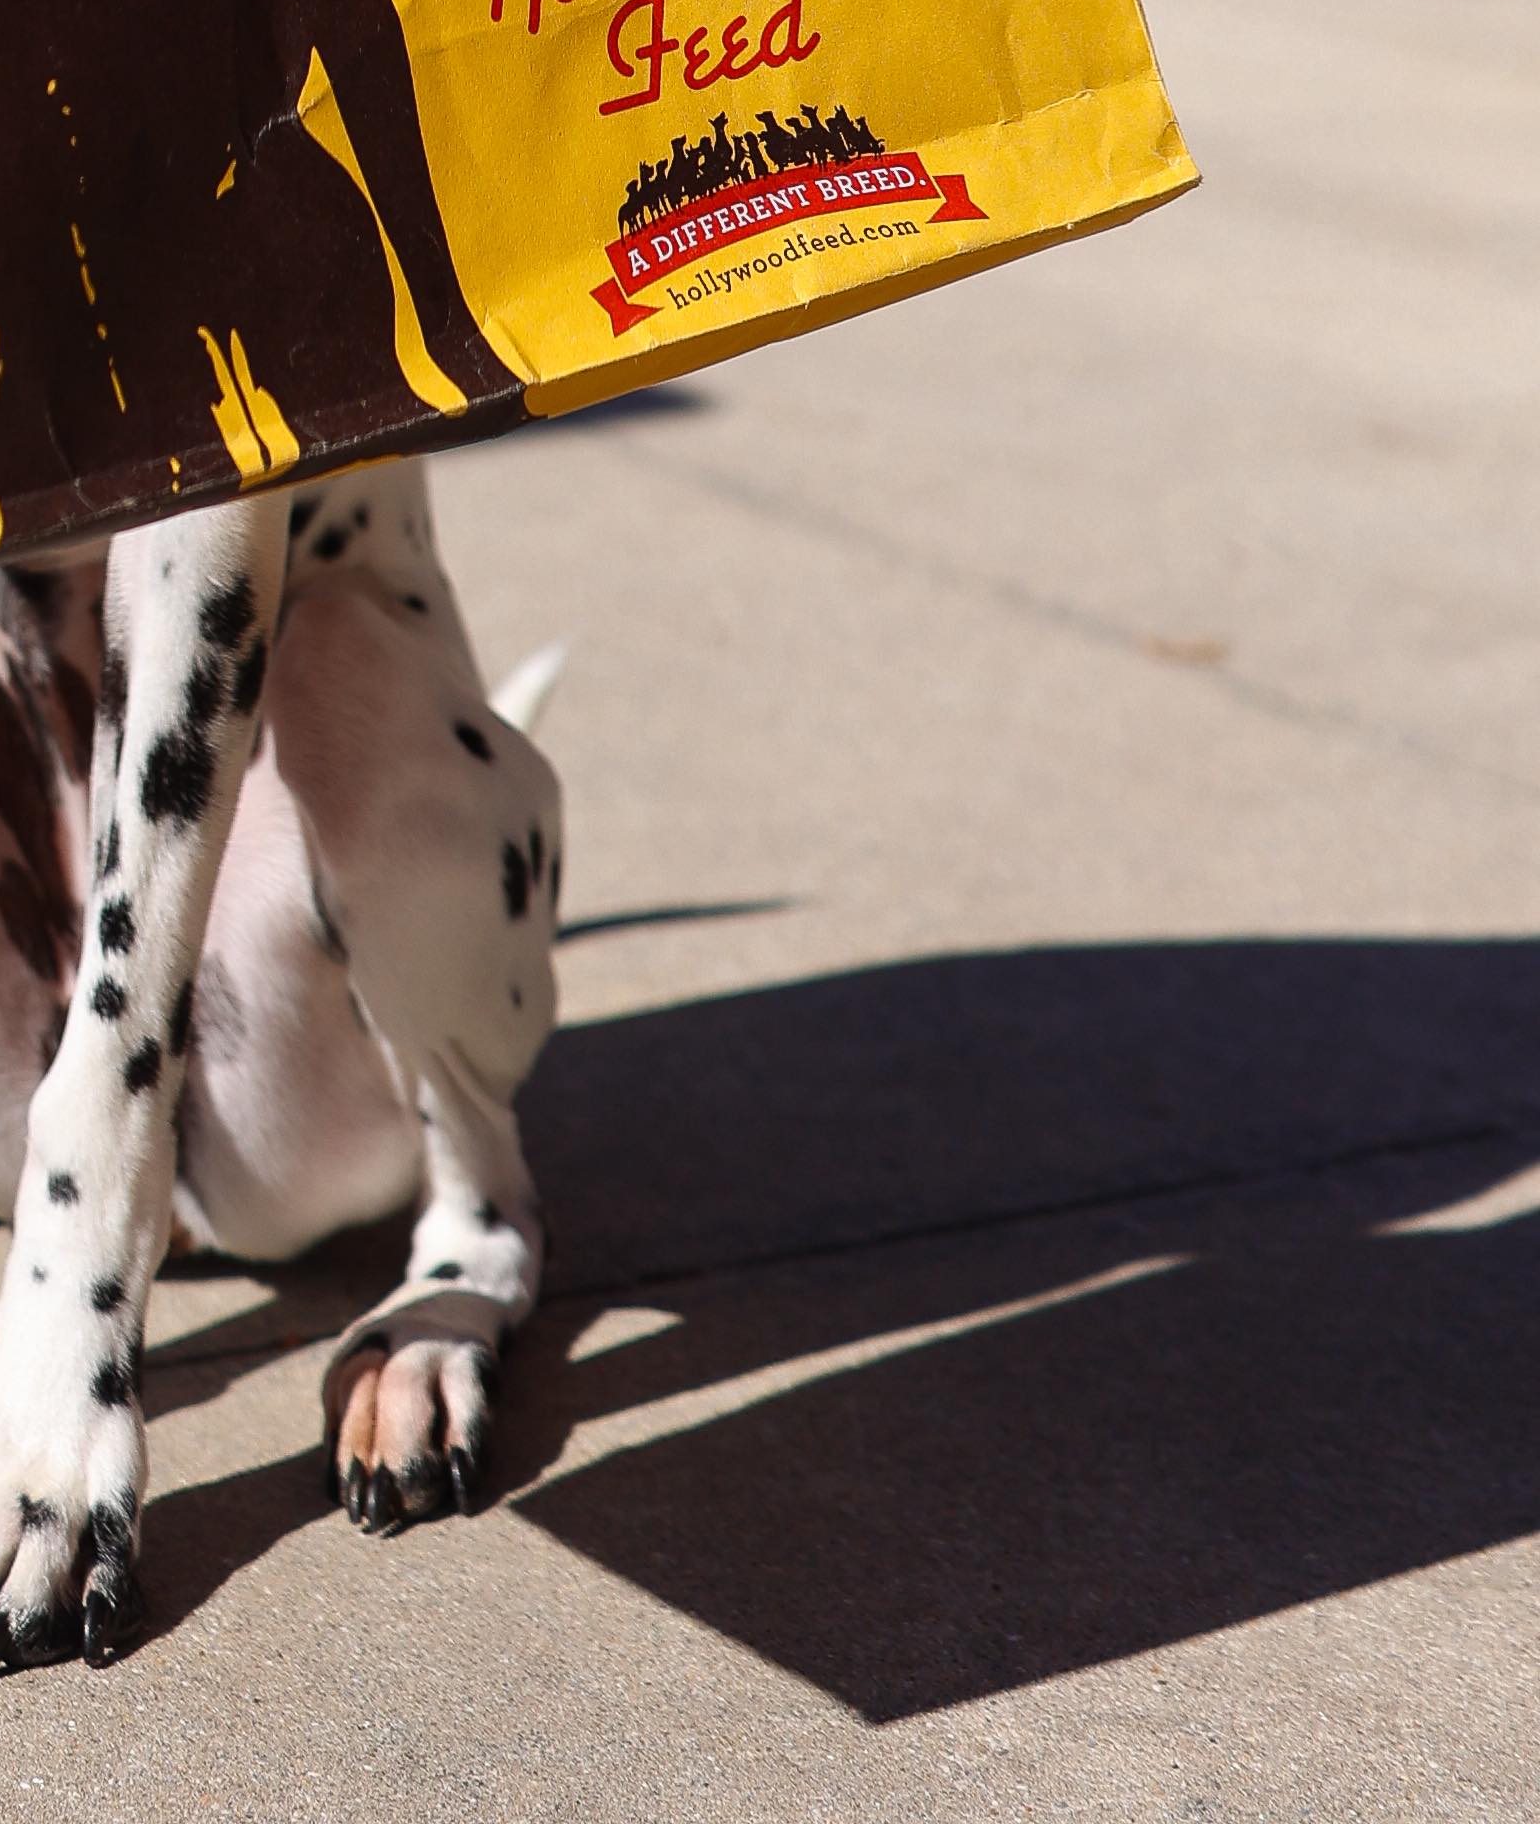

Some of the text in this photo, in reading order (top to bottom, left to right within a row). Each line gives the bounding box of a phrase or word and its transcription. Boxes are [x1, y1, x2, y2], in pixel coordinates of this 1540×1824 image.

[627, 165, 928, 278] A DIFFERENT BREED.
[666, 220, 920, 310] hollywoodfeed.com
